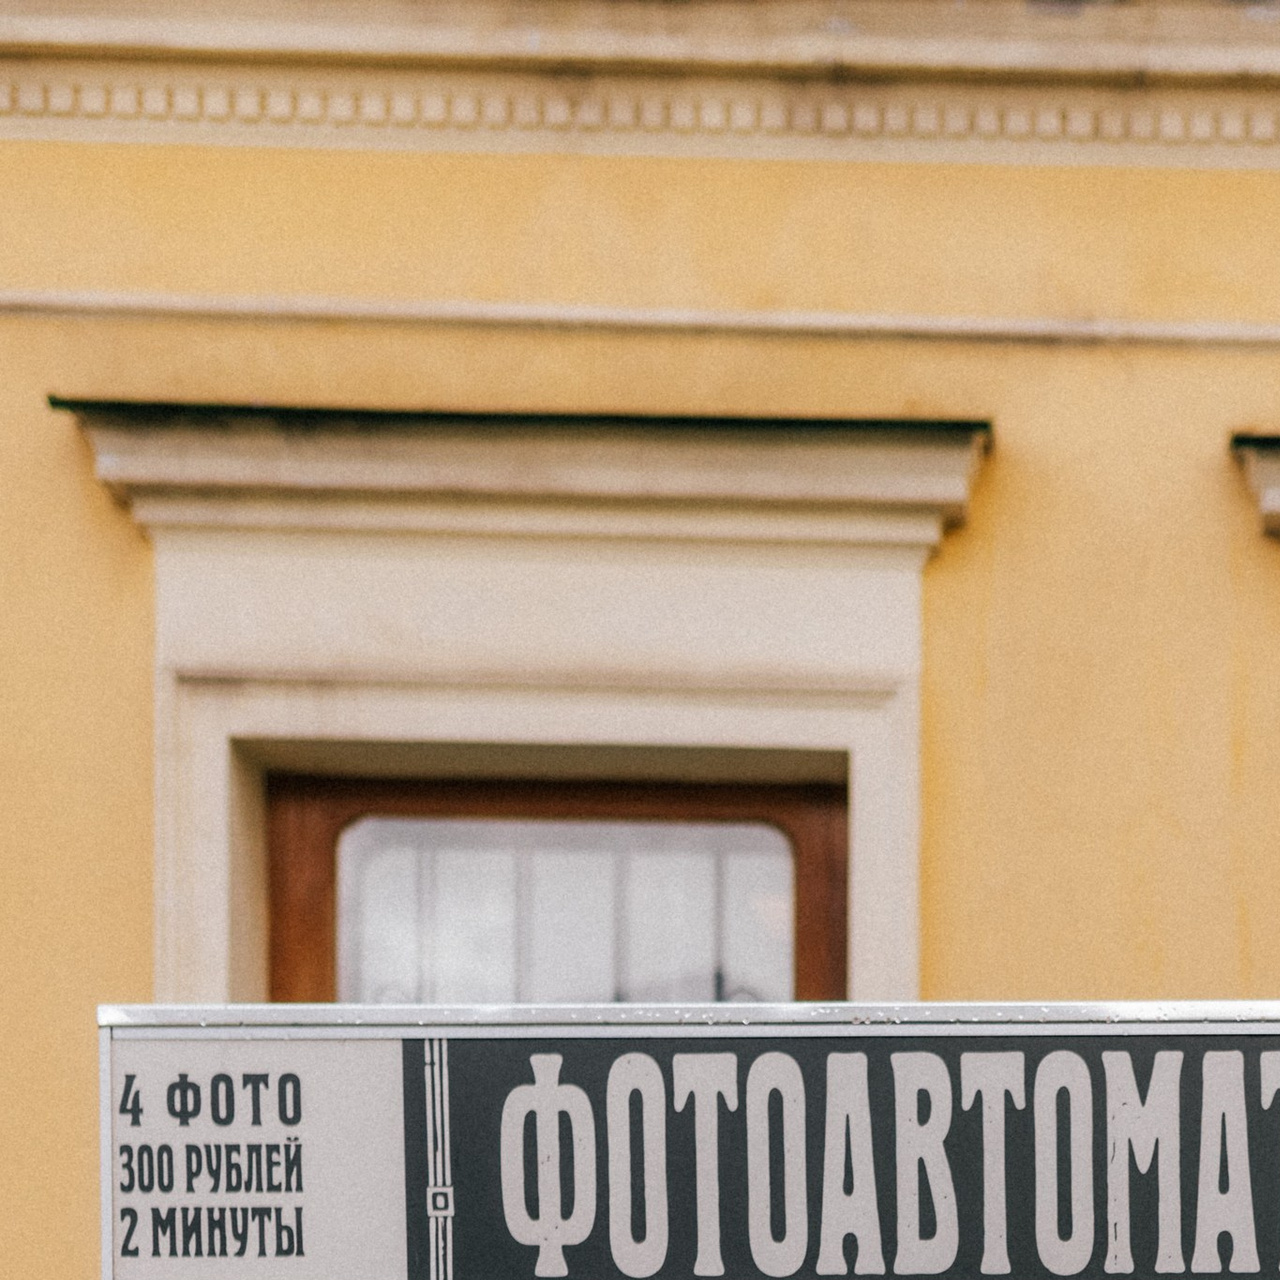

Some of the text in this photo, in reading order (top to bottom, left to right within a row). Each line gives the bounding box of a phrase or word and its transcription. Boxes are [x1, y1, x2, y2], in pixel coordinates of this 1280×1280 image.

[119, 1073, 302, 1127] 4 ФОТО
[119, 1136, 303, 1193] 300 РУБЛЕЙ
[120, 1206, 305, 1257] 2 МИНУТЫ
